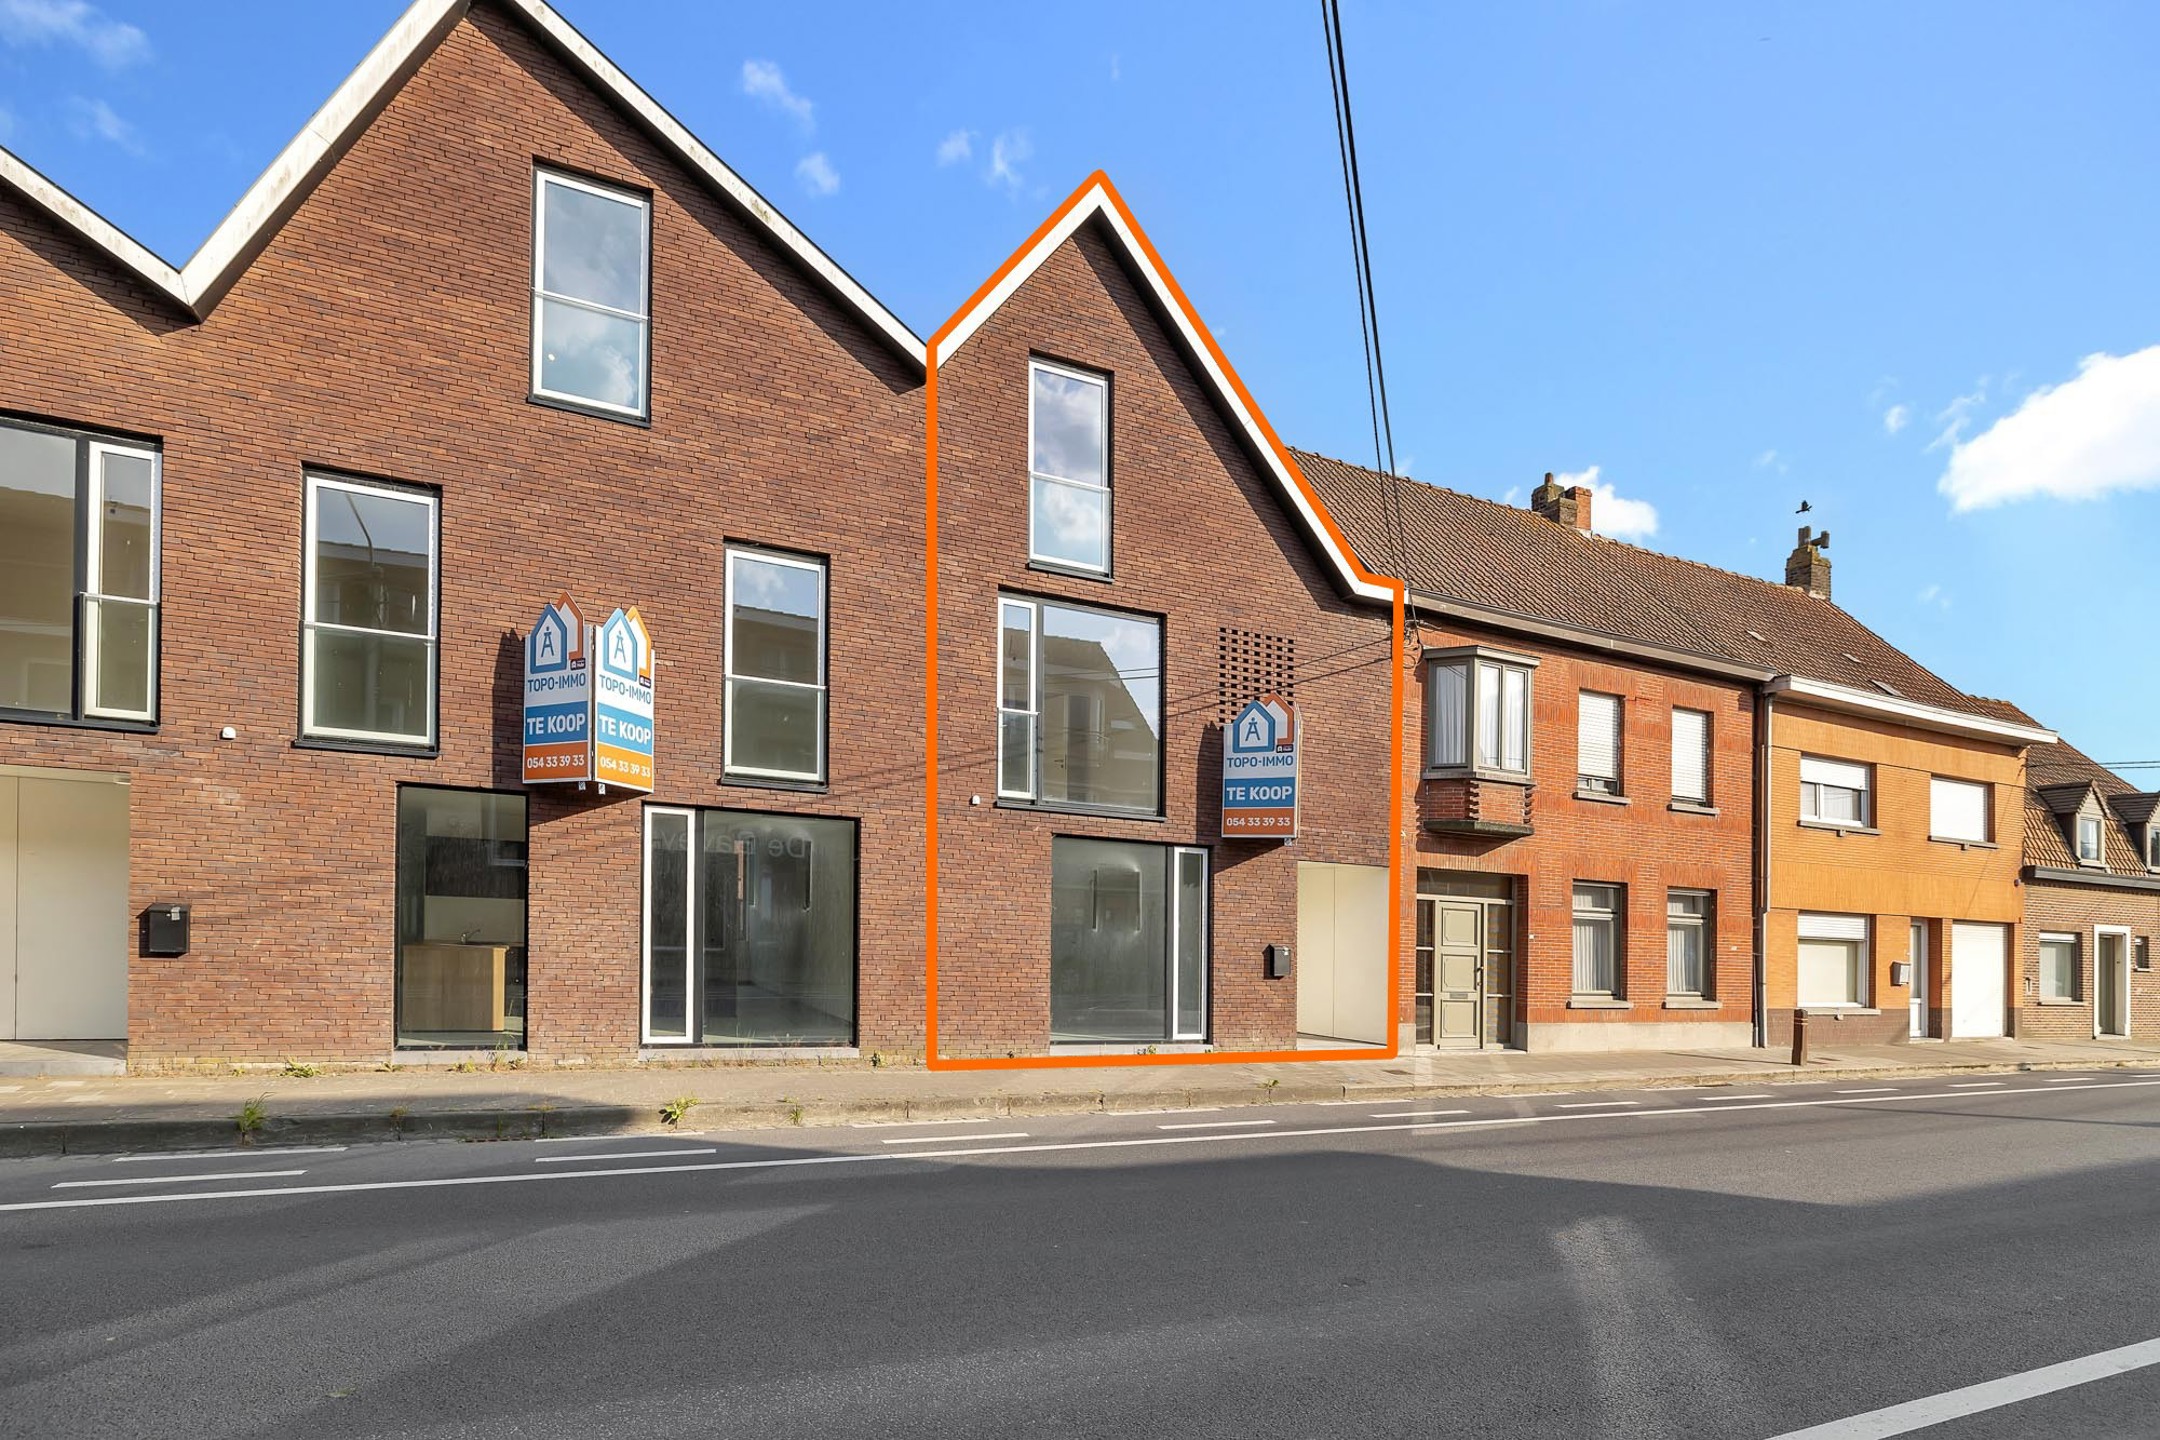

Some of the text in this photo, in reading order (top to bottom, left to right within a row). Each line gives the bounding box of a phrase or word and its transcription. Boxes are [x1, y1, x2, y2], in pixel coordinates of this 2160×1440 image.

[528, 673, 586, 692] TOPO-IMMO
[599, 674, 652, 704] TOPO-IMMO
[527, 713, 586, 735] TE KOOP
[599, 714, 652, 745] TE KOOP
[527, 754, 585, 768] 054 33 39 33
[600, 757, 651, 777] 054 33 39 33
[1226, 755, 1294, 768] TOPO-IMMO
[1226, 786, 1293, 801] TE KOOP
[1226, 817, 1291, 826] 054 33 39 33
